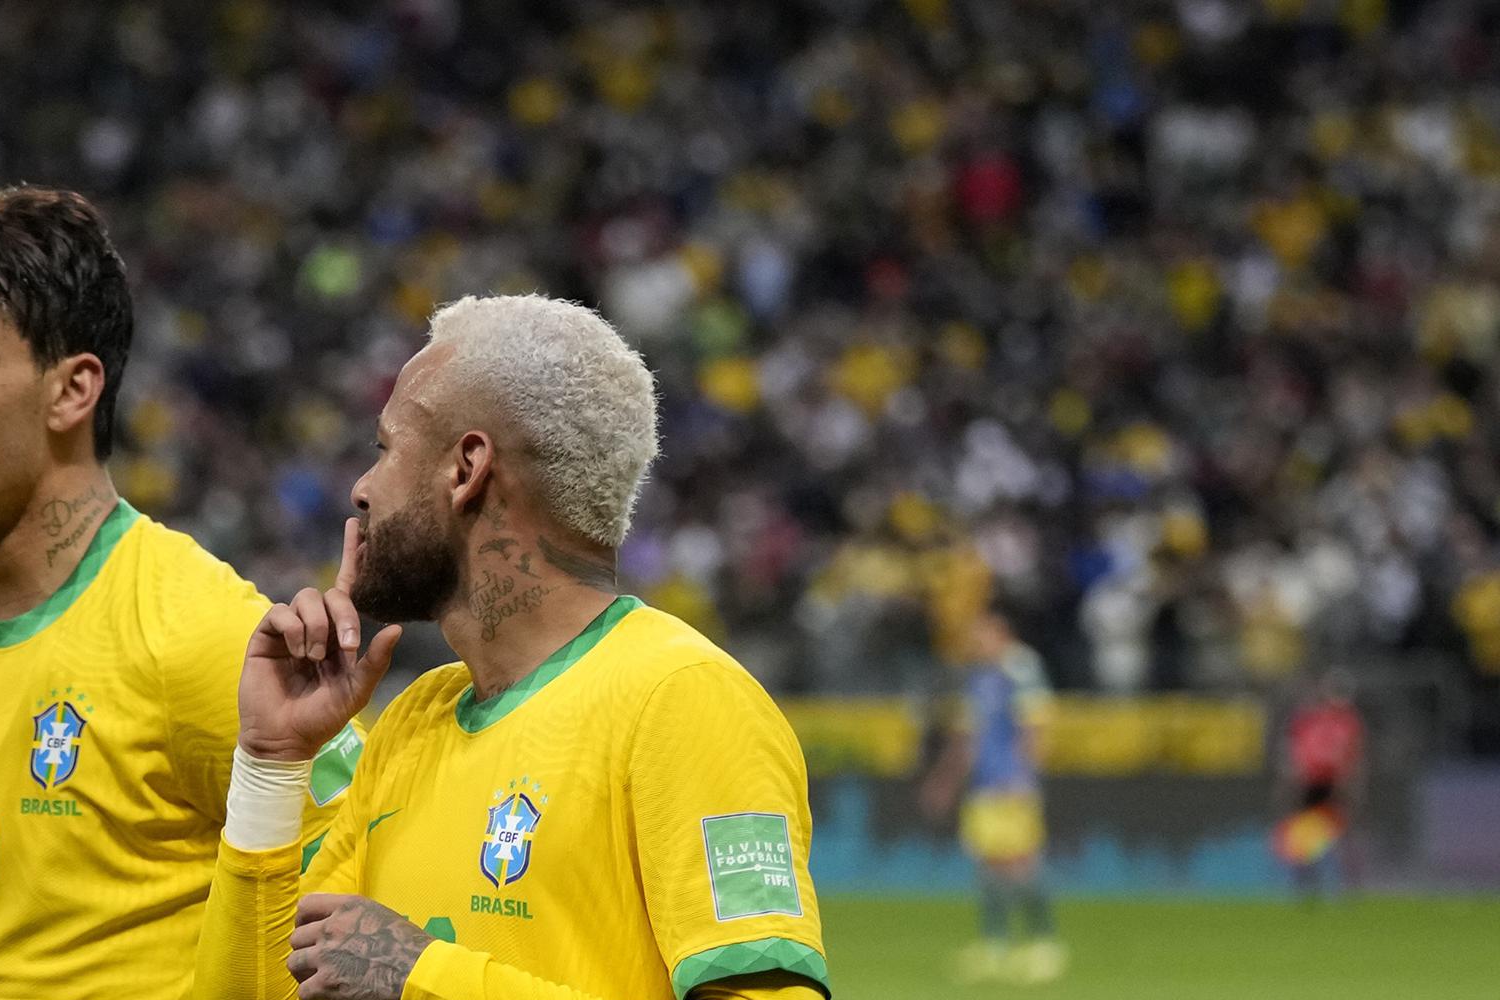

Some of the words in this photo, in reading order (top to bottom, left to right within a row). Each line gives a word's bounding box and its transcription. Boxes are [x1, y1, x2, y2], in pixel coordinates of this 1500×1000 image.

[46, 737, 67, 749] CBF
[340, 735, 359, 759] FIFA
[20, 798, 83, 817] BRASIL
[498, 831, 519, 844] CBF
[714, 840, 786, 857] LIVING
[716, 852, 787, 868] FOOTBALL
[763, 873, 791, 888] FIFA
[470, 895, 534, 920] BRASIL
